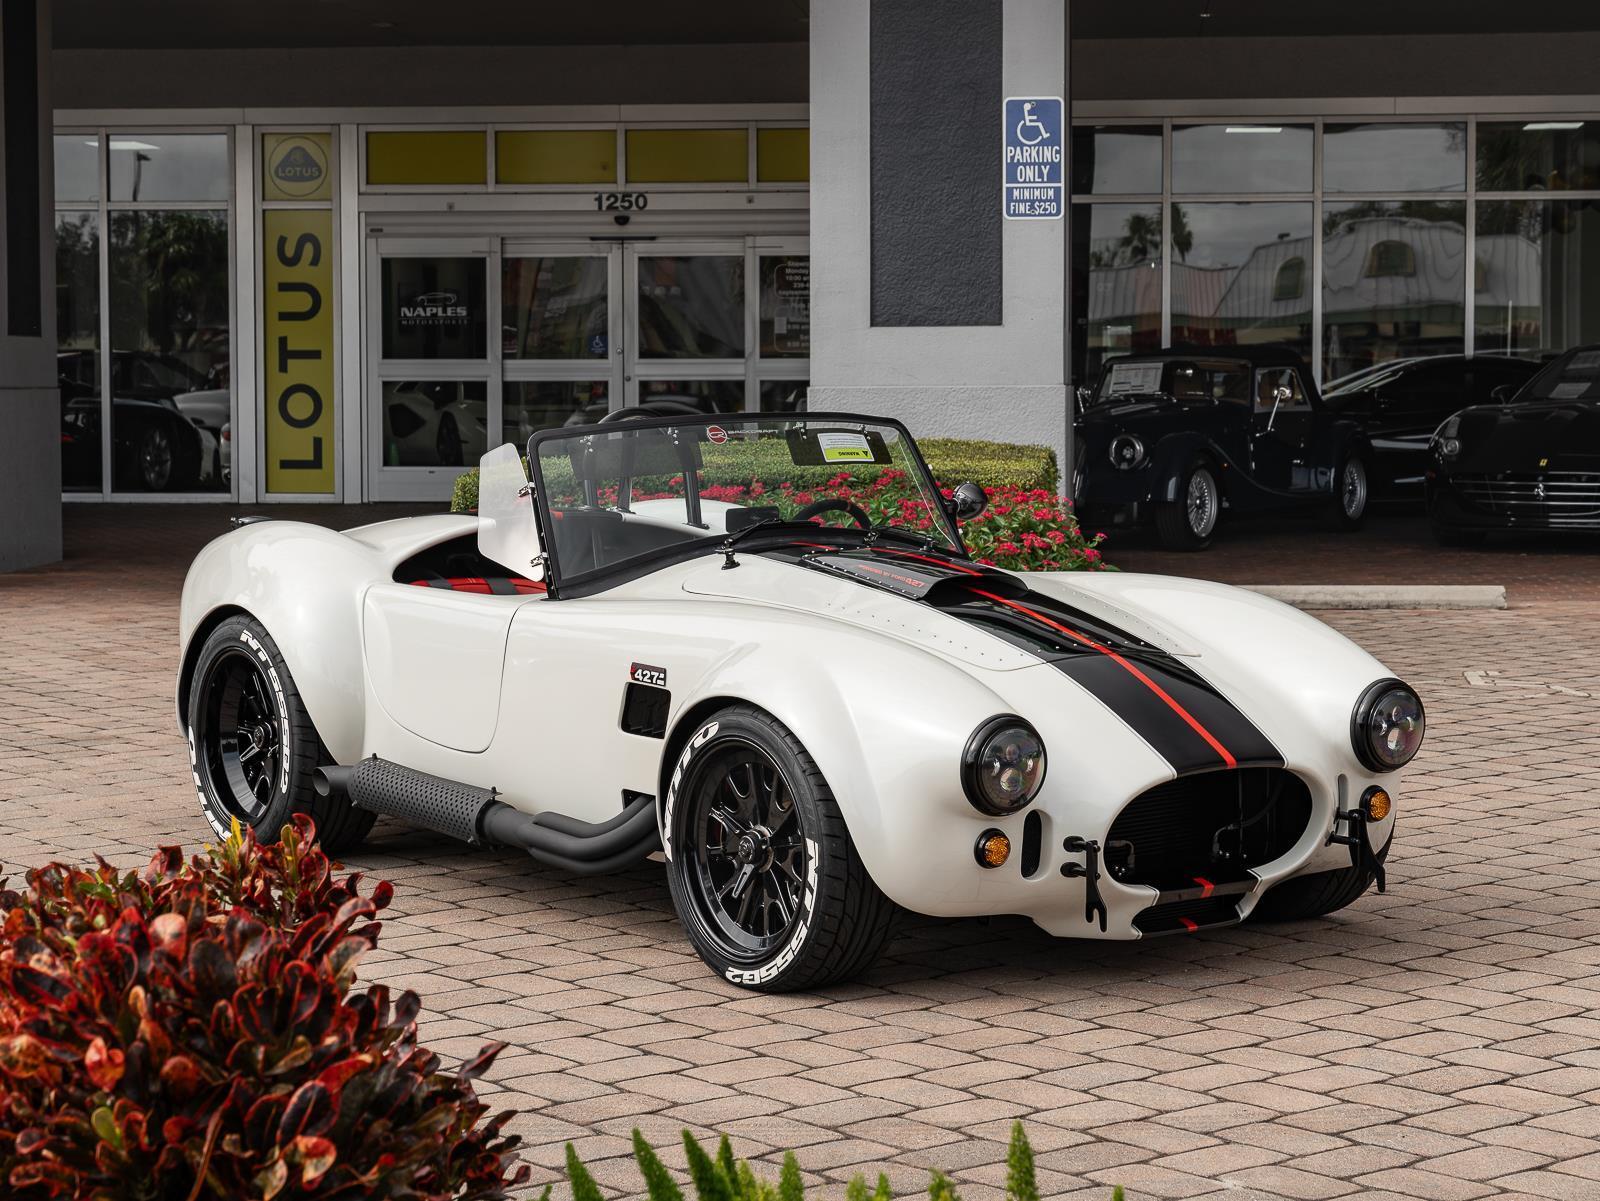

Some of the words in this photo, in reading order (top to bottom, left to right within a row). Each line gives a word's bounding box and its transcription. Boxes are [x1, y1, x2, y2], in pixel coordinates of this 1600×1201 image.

[1007, 145, 1061, 163] PARKING
[278, 167, 319, 177] LOTUS
[1017, 165, 1050, 182] ONLY
[1013, 187, 1054, 200] MINIMUM
[593, 192, 648, 211] 1250
[1010, 202, 1031, 214] FINE
[1034, 201, 1057, 215] $250
[400, 306, 467, 317] NAPLES
[277, 231, 323, 471] LOTUS
[905, 577, 925, 588] 427
[634, 668, 659, 684] 427
